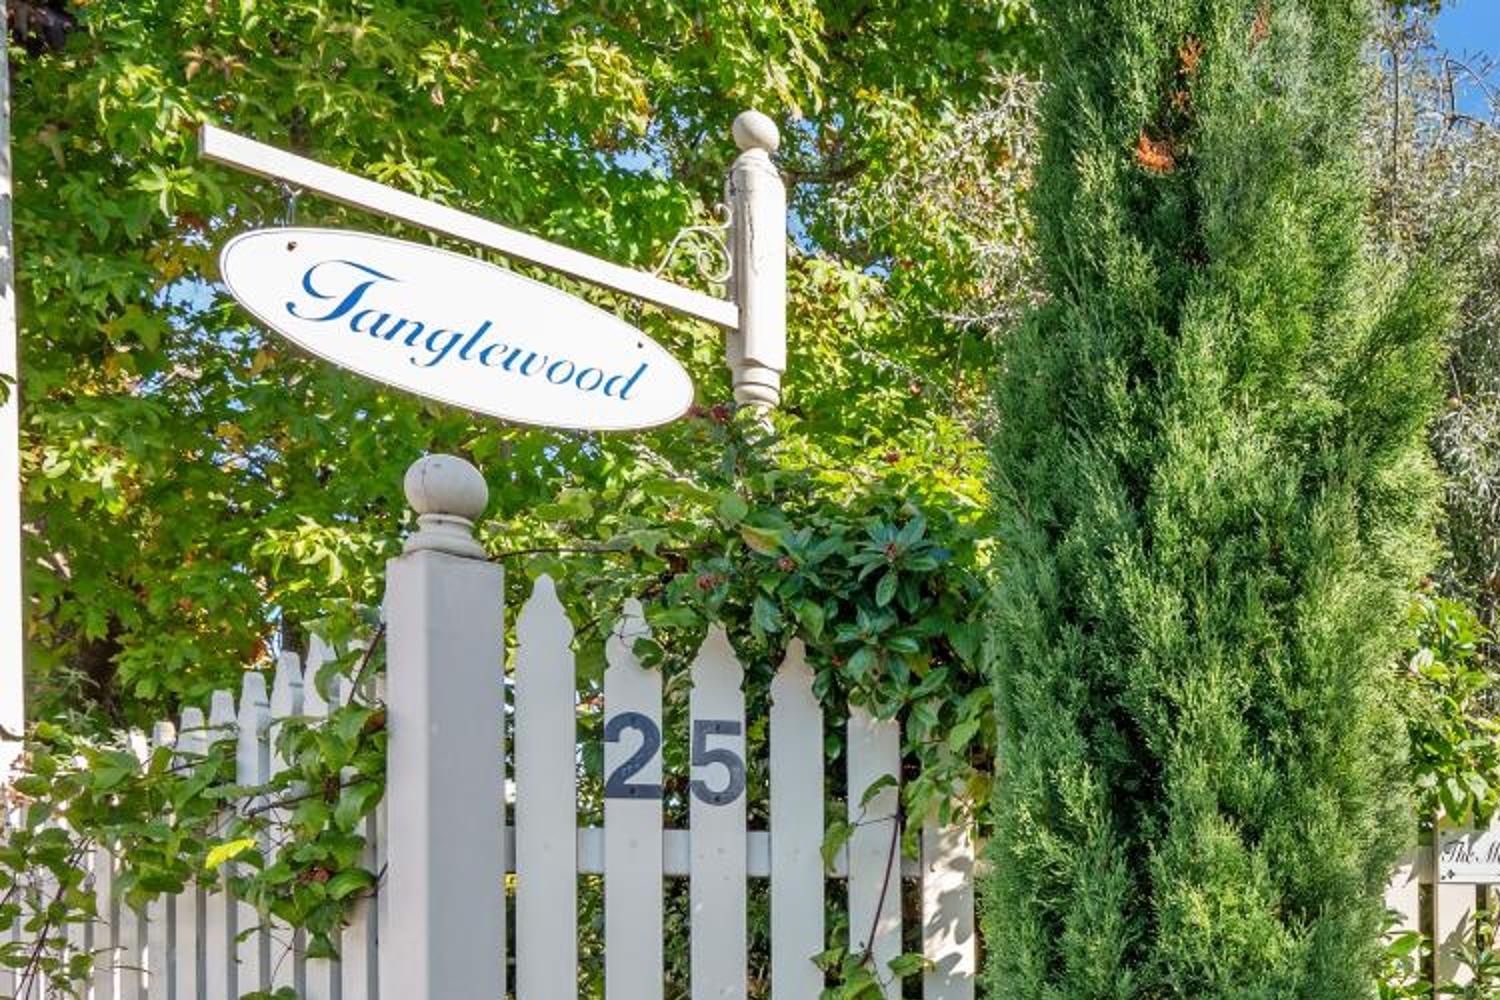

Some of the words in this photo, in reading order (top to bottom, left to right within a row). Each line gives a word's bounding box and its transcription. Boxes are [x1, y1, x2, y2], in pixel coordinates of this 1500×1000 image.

[285, 258, 649, 401] Tanglewood
[603, 711, 747, 806] 25
[1440, 840, 1474, 863] The
